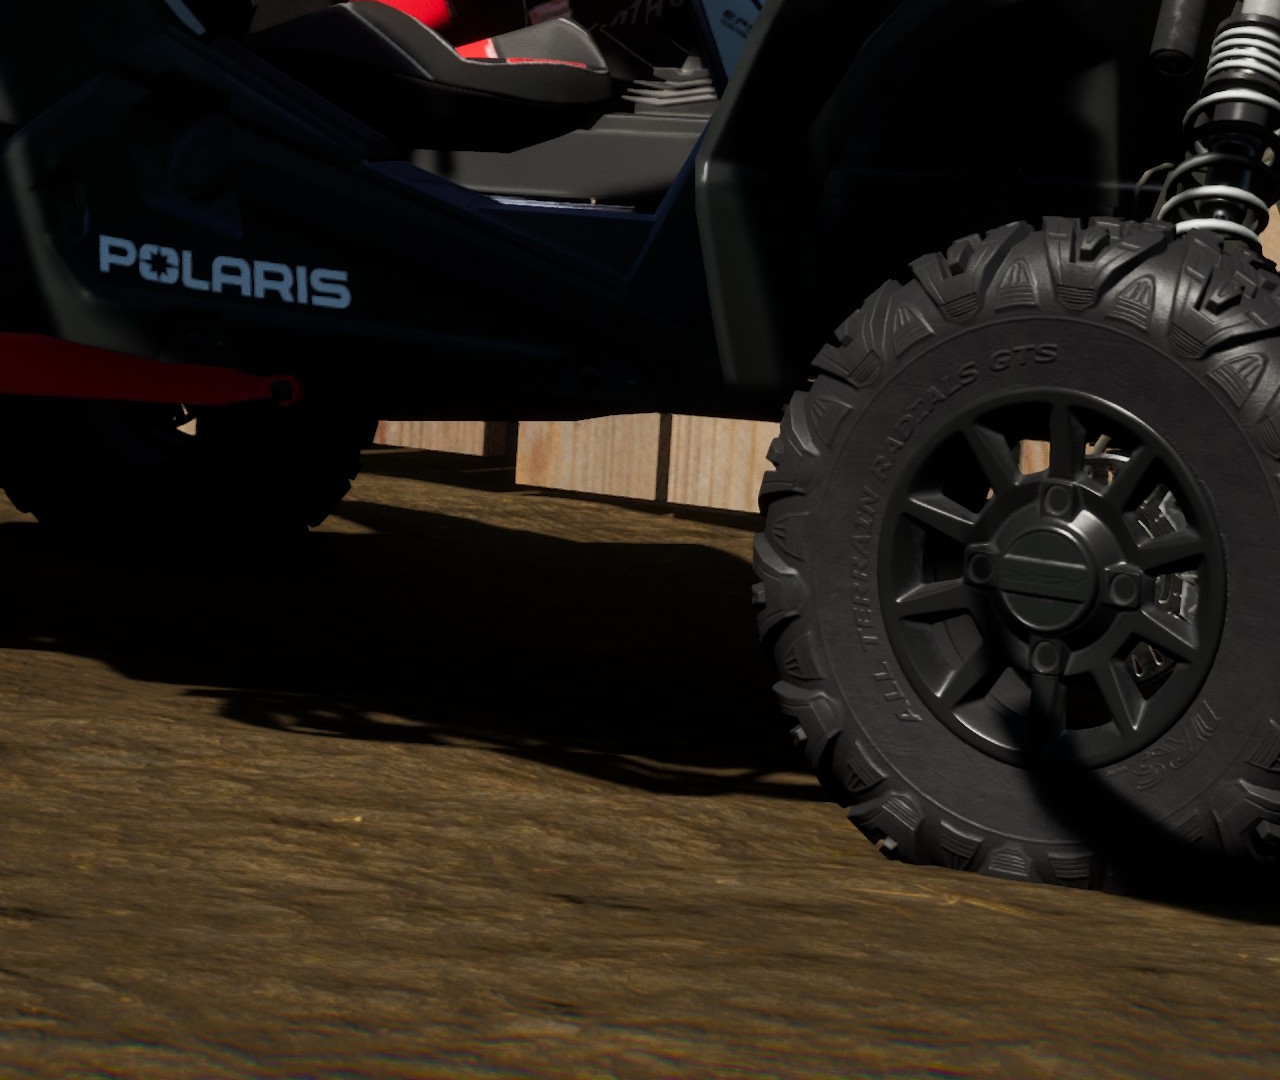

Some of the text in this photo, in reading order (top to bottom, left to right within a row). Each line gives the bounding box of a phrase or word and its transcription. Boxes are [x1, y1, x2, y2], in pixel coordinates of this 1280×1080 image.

[98, 233, 353, 311] POLARIS
[849, 484, 884, 653] TERRAIN
[872, 360, 981, 478] RADIALS
[987, 342, 1060, 373] GTS
